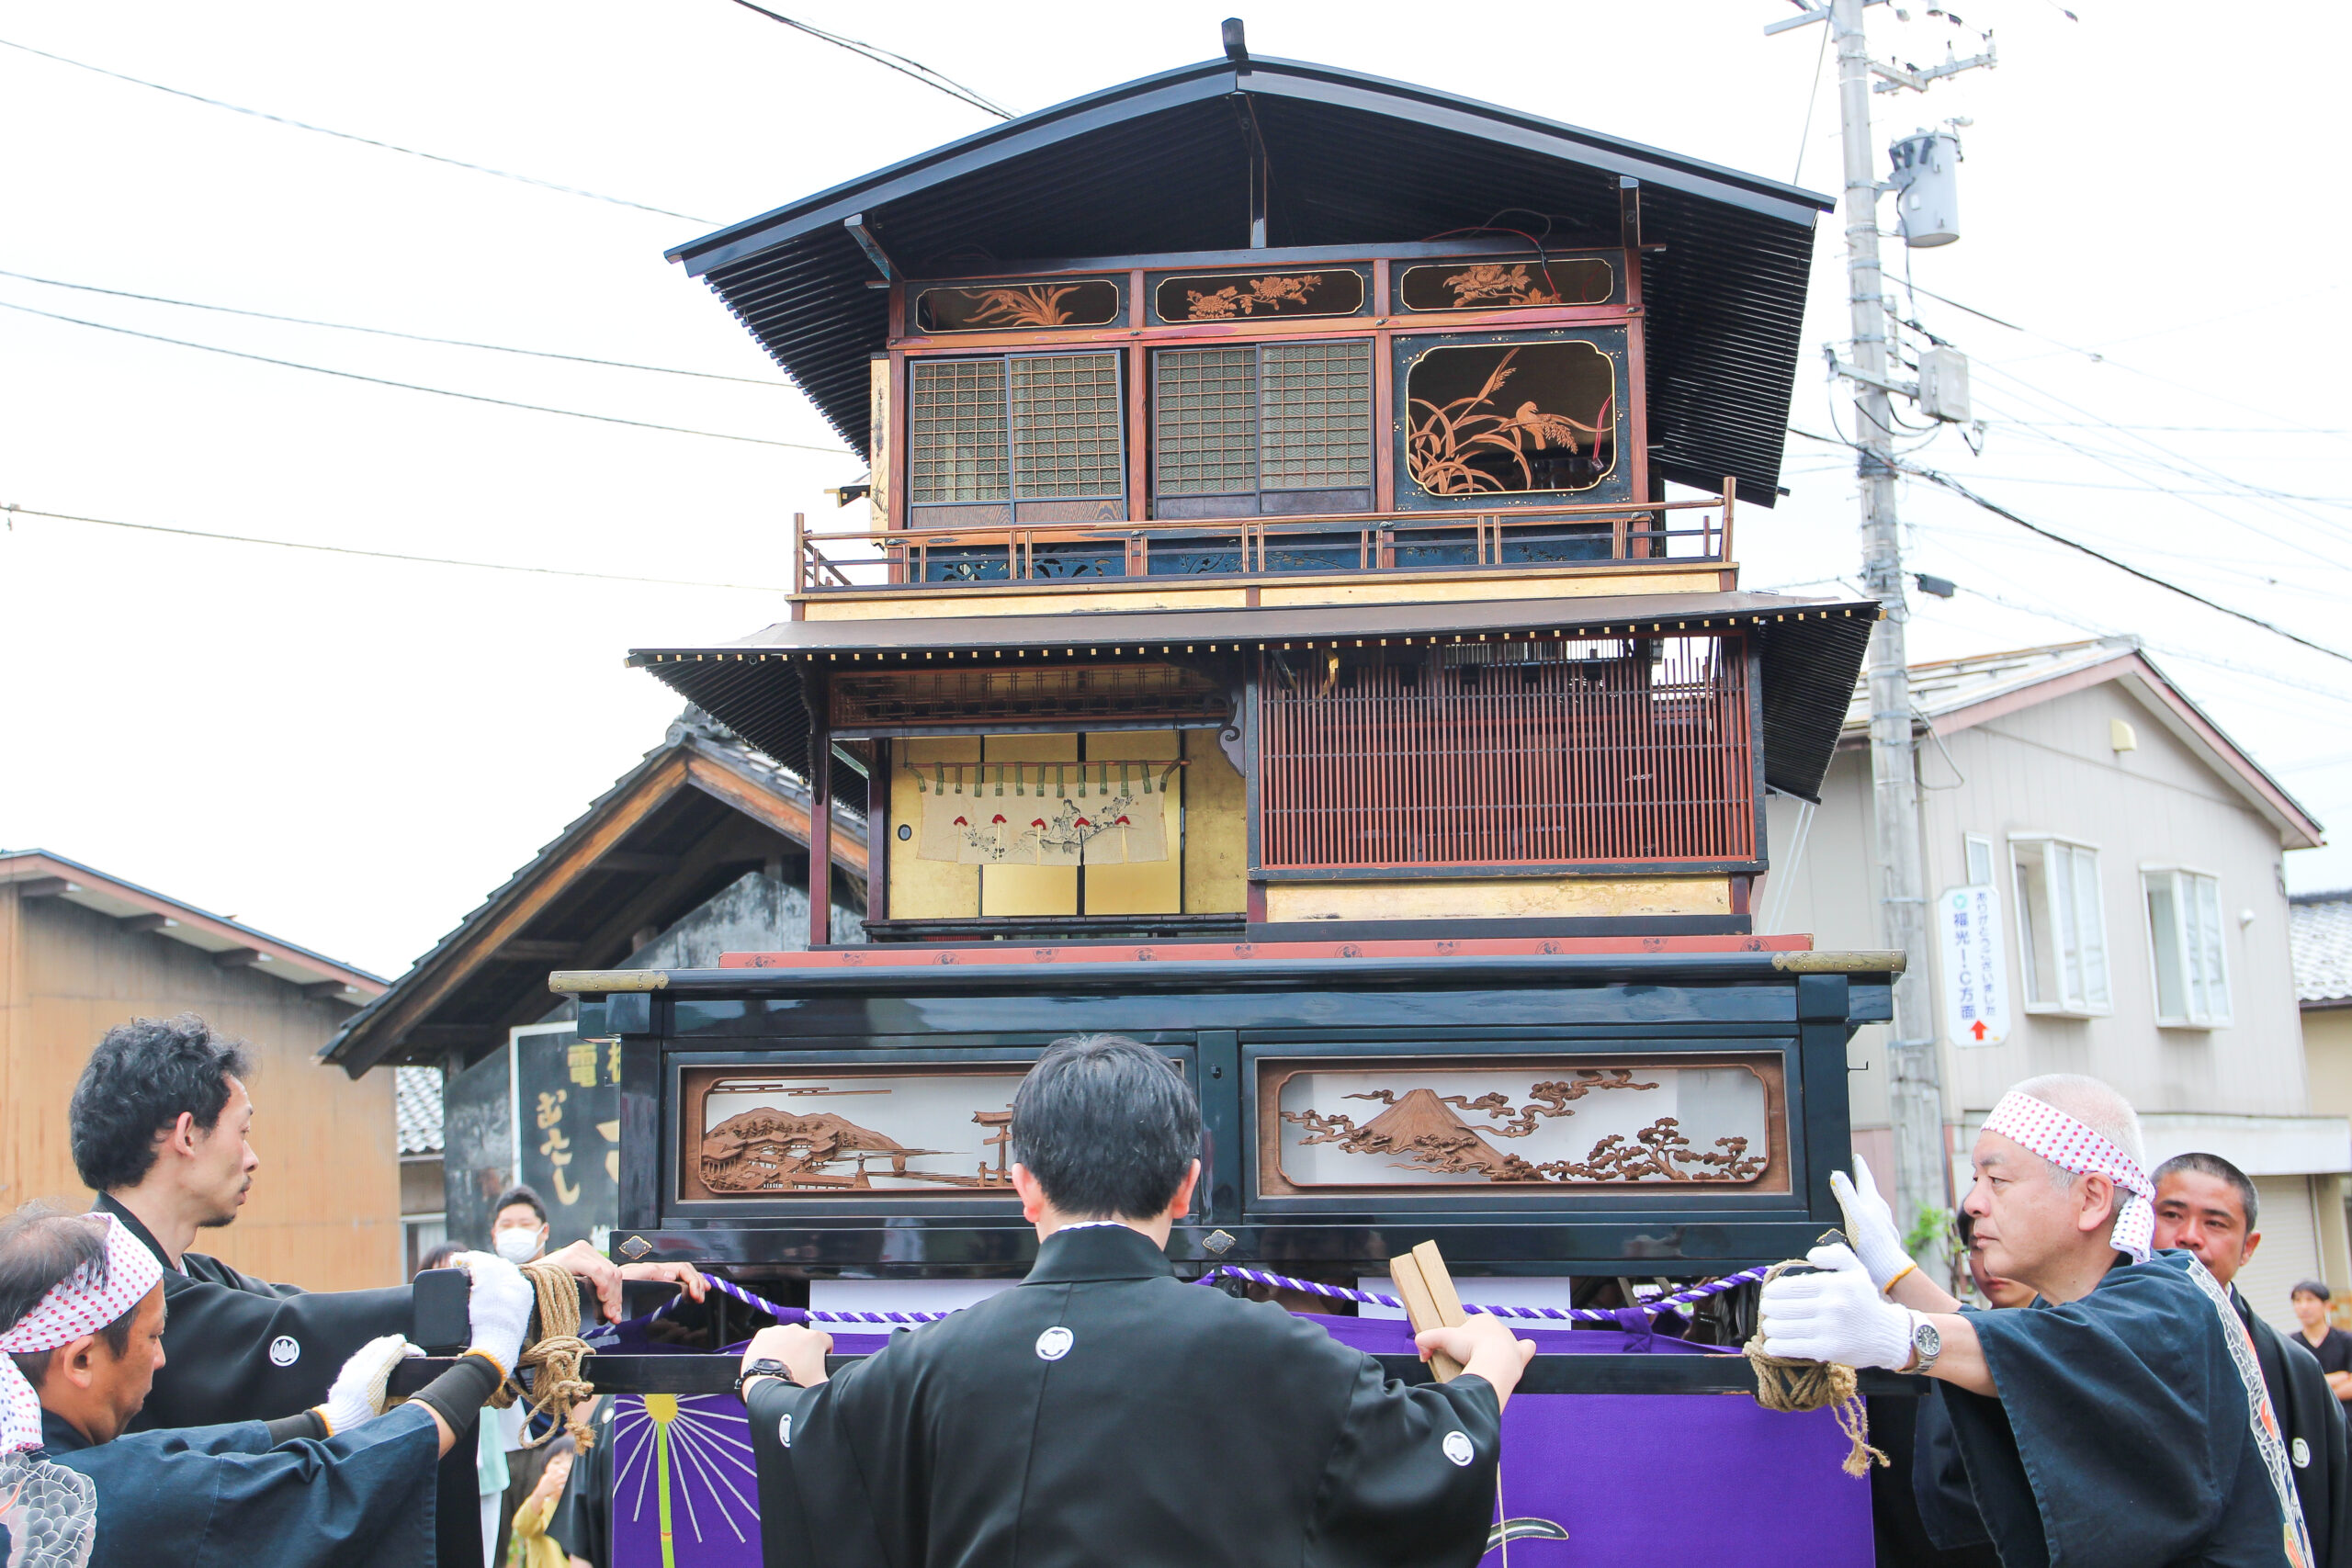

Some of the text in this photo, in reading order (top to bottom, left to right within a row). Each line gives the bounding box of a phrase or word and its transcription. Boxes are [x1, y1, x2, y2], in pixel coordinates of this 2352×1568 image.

[1977, 892, 1996, 1016] ありがとうございました
